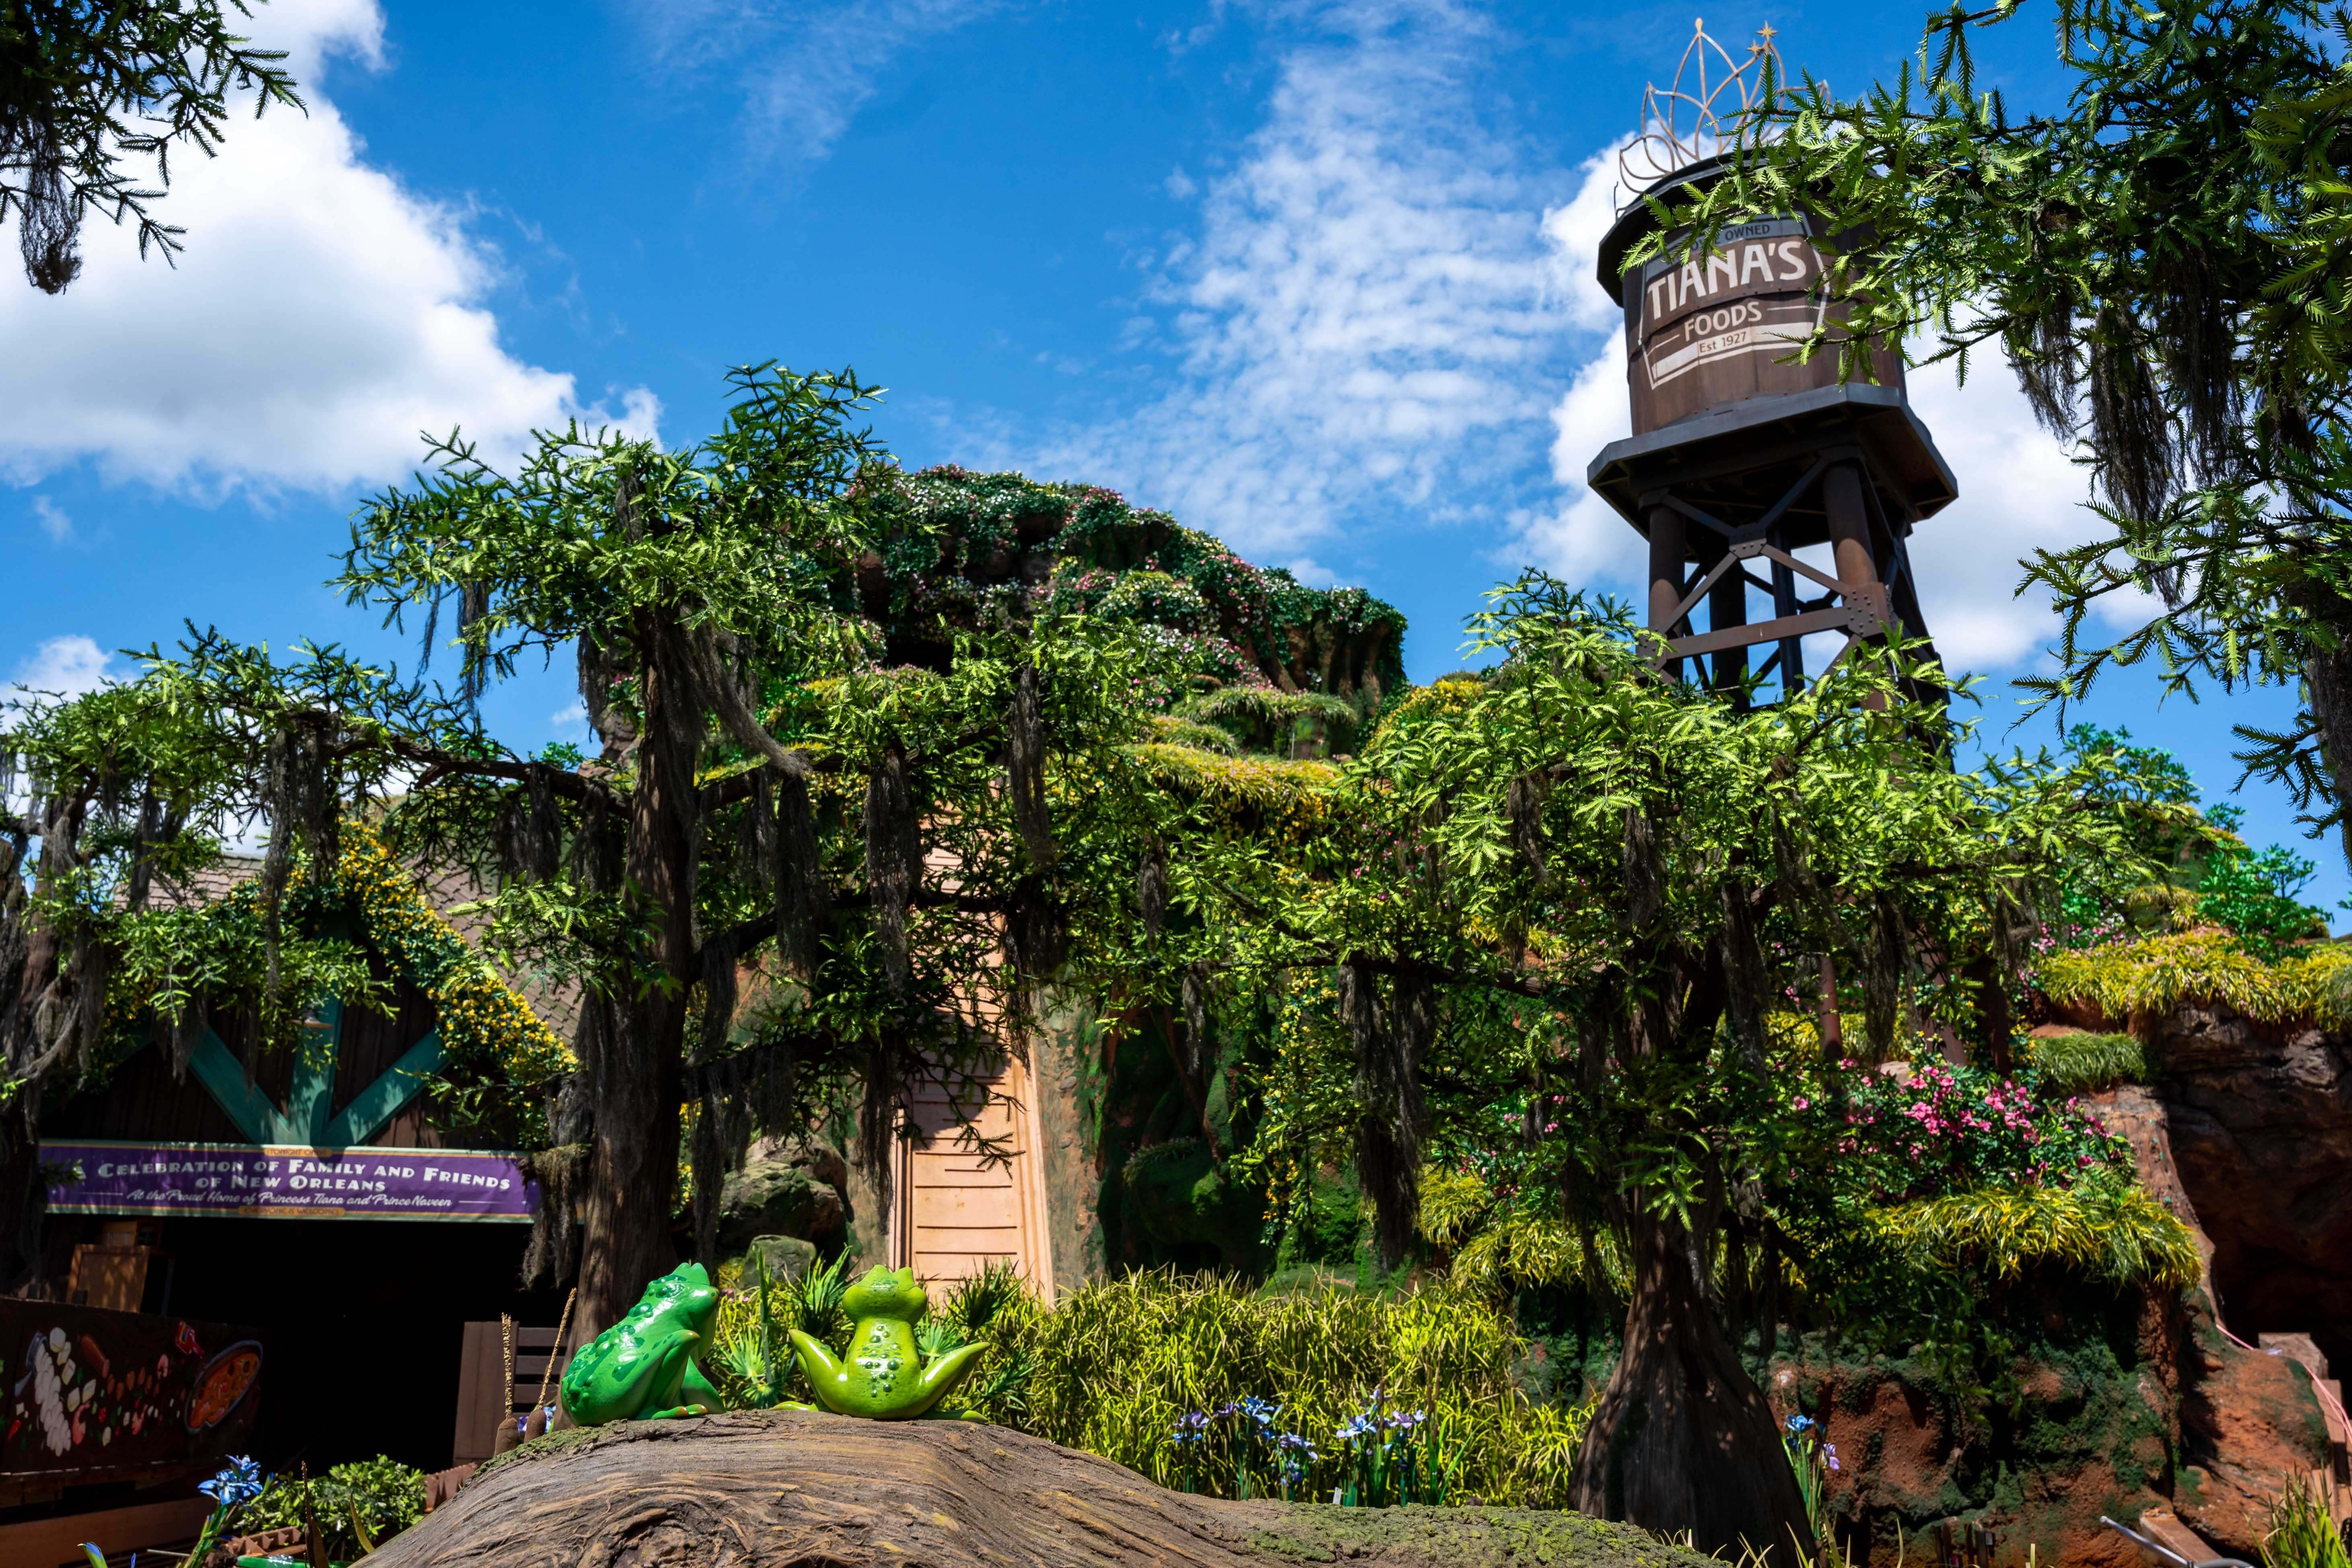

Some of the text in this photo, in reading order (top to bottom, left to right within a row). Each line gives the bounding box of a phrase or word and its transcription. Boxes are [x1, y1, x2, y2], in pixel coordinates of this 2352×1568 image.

[1725, 224, 1770, 240] OWNED
[1648, 242, 1806, 320] TIANA'S
[1684, 302, 1762, 341] FOODS
[1699, 332, 1746, 353] Est 1927
[98, 1161, 244, 1178] CELEBRATION
[254, 1161, 280, 1172] OF
[288, 1159, 366, 1175] FAMILY
[374, 1165, 415, 1178] AND
[424, 1167, 510, 1190] FRIENDS
[195, 1175, 386, 1192] OF NEW ORLEANS
[126, 1189, 453, 1206] At the Proud Home of Princess Tiana and Prince Naveen
